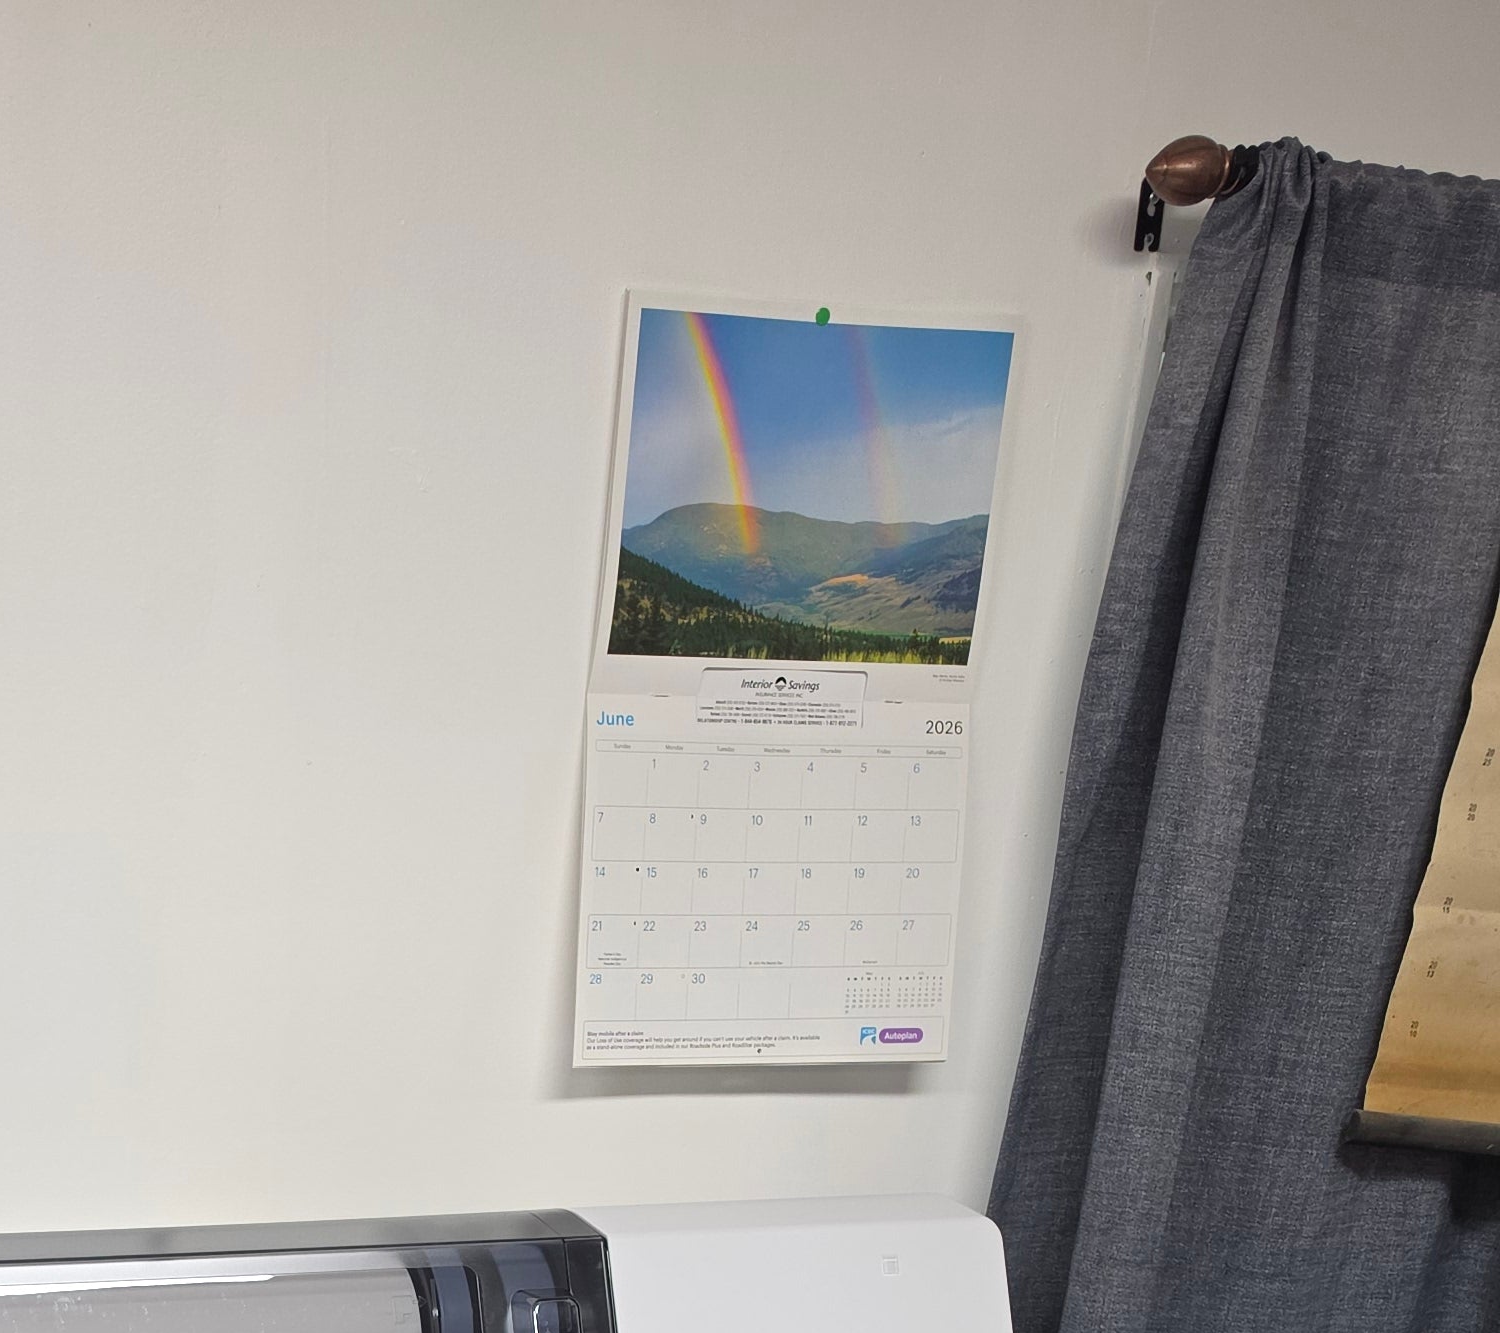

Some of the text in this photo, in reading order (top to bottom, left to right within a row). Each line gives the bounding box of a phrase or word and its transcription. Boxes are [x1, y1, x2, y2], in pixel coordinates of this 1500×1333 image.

[741, 679, 820, 692] Interior Savings
[597, 711, 635, 727] June
[925, 720, 963, 735] 2026
[652, 758, 920, 773] 1 2 3 4 5 6
[598, 811, 920, 826] 7 8 9 10 11 12 13
[596, 866, 919, 878] 14 15 16 17 18 19 20
[592, 920, 914, 932] 21 22 23 24 25 26 27
[590, 973, 705, 984] 28 29 30
[884, 1032, 918, 1041] Autoplan
